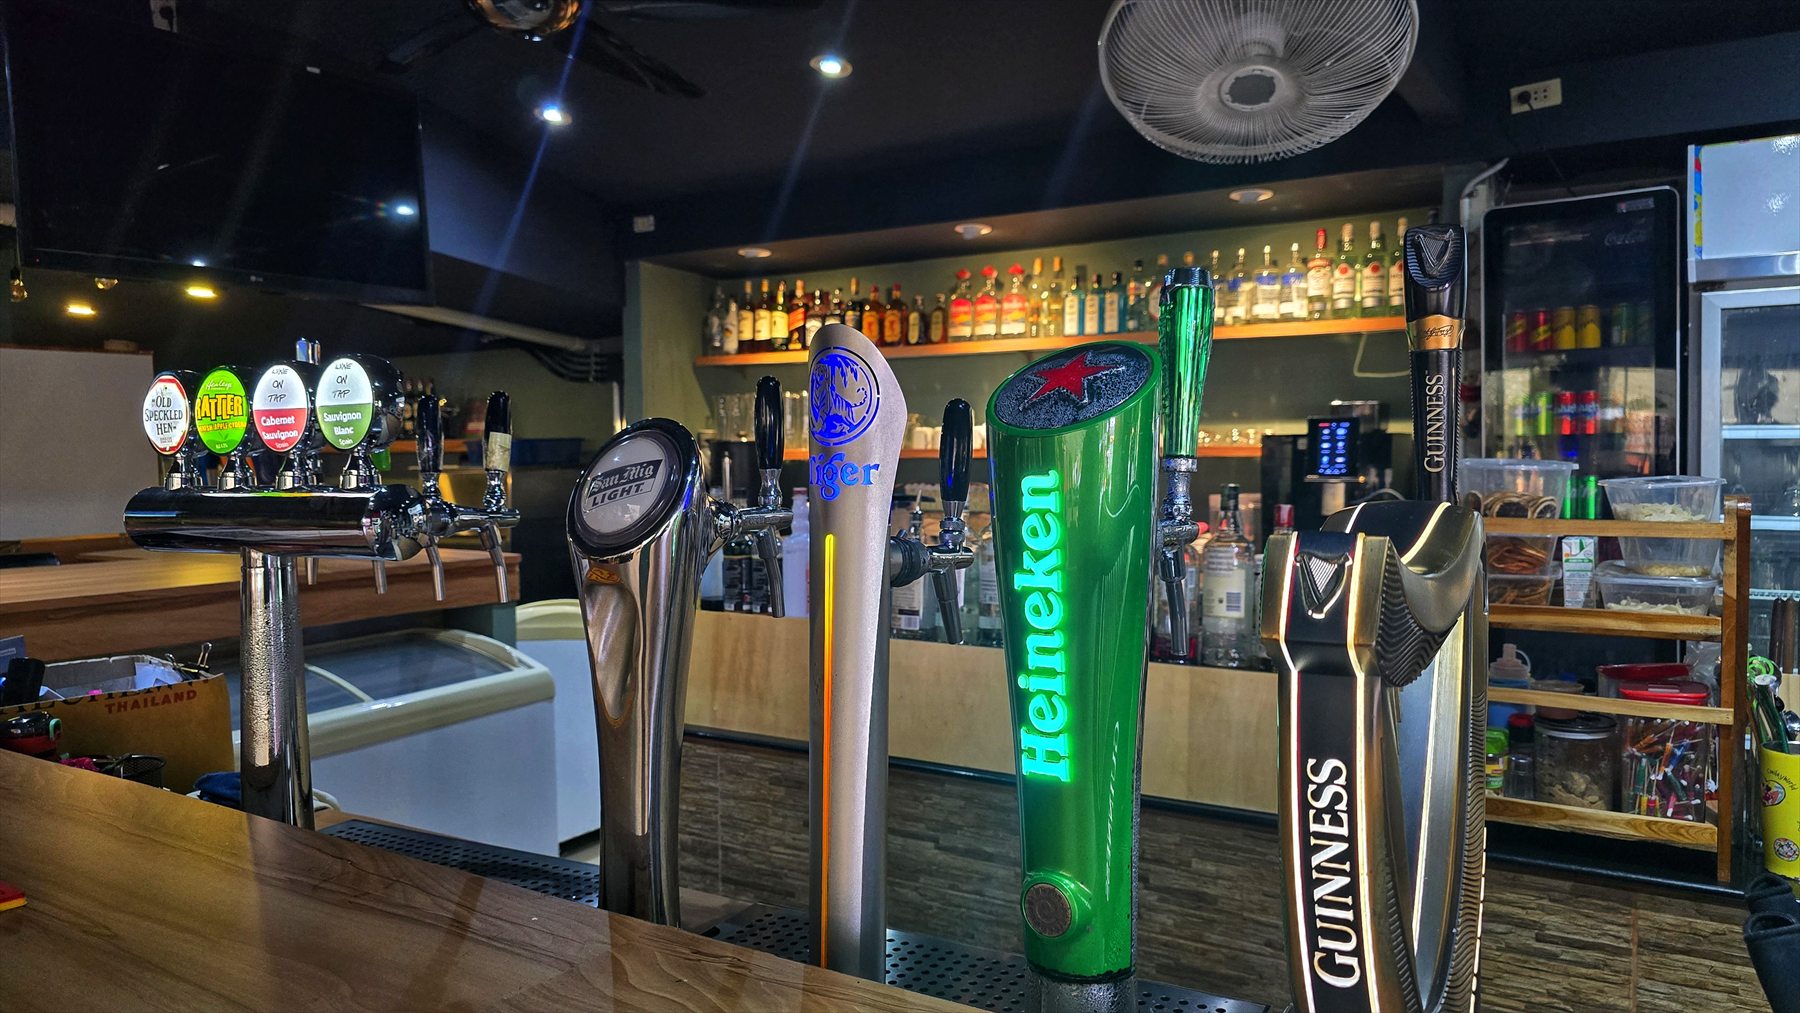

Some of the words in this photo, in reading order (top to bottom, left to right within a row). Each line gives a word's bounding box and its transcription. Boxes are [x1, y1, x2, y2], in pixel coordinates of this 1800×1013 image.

[272, 380, 284, 389] ON
[336, 375, 348, 385] ON
[268, 393, 287, 403] TAP
[332, 389, 351, 399] TAP
[155, 395, 172, 408] OLD
[196, 393, 244, 421] RATTLER
[144, 408, 183, 422] SPECKLED
[260, 415, 296, 426] Cabernet
[323, 411, 362, 422] Sauvignon
[156, 422, 173, 436] HEN
[1423, 373, 1446, 474] GUINNESS
[262, 429, 299, 440] Sauvignon
[333, 426, 354, 435] Blanc
[592, 475, 619, 493] San
[620, 463, 654, 483] Mig
[591, 482, 645, 507] LIGHT
[1013, 469, 1070, 782] Heineken
[104, 689, 198, 714] THAILAND
[1306, 758, 1361, 988] GUINNESS
